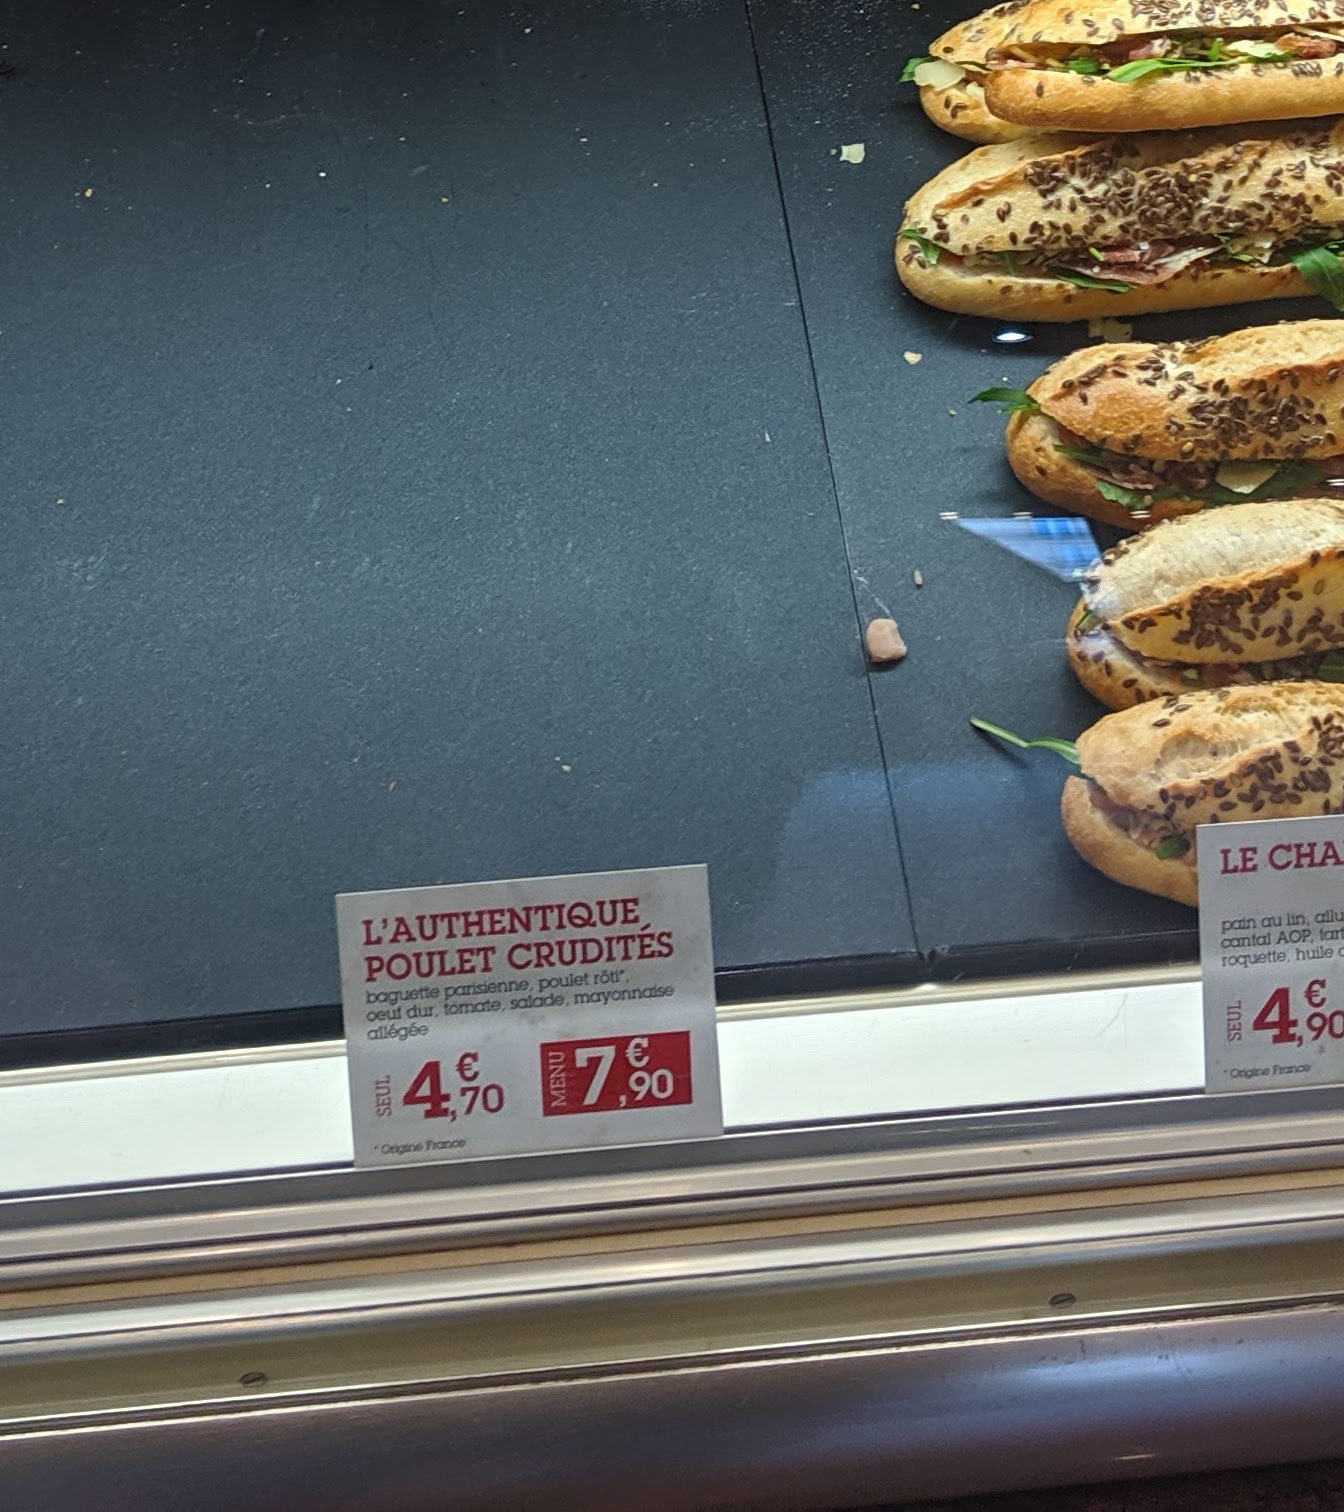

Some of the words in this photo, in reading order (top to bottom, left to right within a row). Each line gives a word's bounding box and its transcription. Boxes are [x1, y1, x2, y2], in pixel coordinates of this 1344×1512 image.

[1220, 847, 1258, 875] LE
[1221, 917, 1256, 934] pain
[1261, 915, 1282, 928] au
[364, 946, 496, 983] POULET
[506, 923, 675, 971] CRUDITÉS
[1220, 933, 1272, 949] cantal
[1295, 945, 1333, 961] huile
[365, 981, 441, 1004] baguette
[538, 972, 591, 992] poulet
[365, 1006, 404, 1022] oeuf
[573, 984, 675, 1008] mayonnaise
[367, 1023, 429, 1043] allégée
[1227, 1000, 1242, 1042] SEUL
[545, 1050, 566, 1108] MENU
[377, 1075, 392, 1117] SEUL
